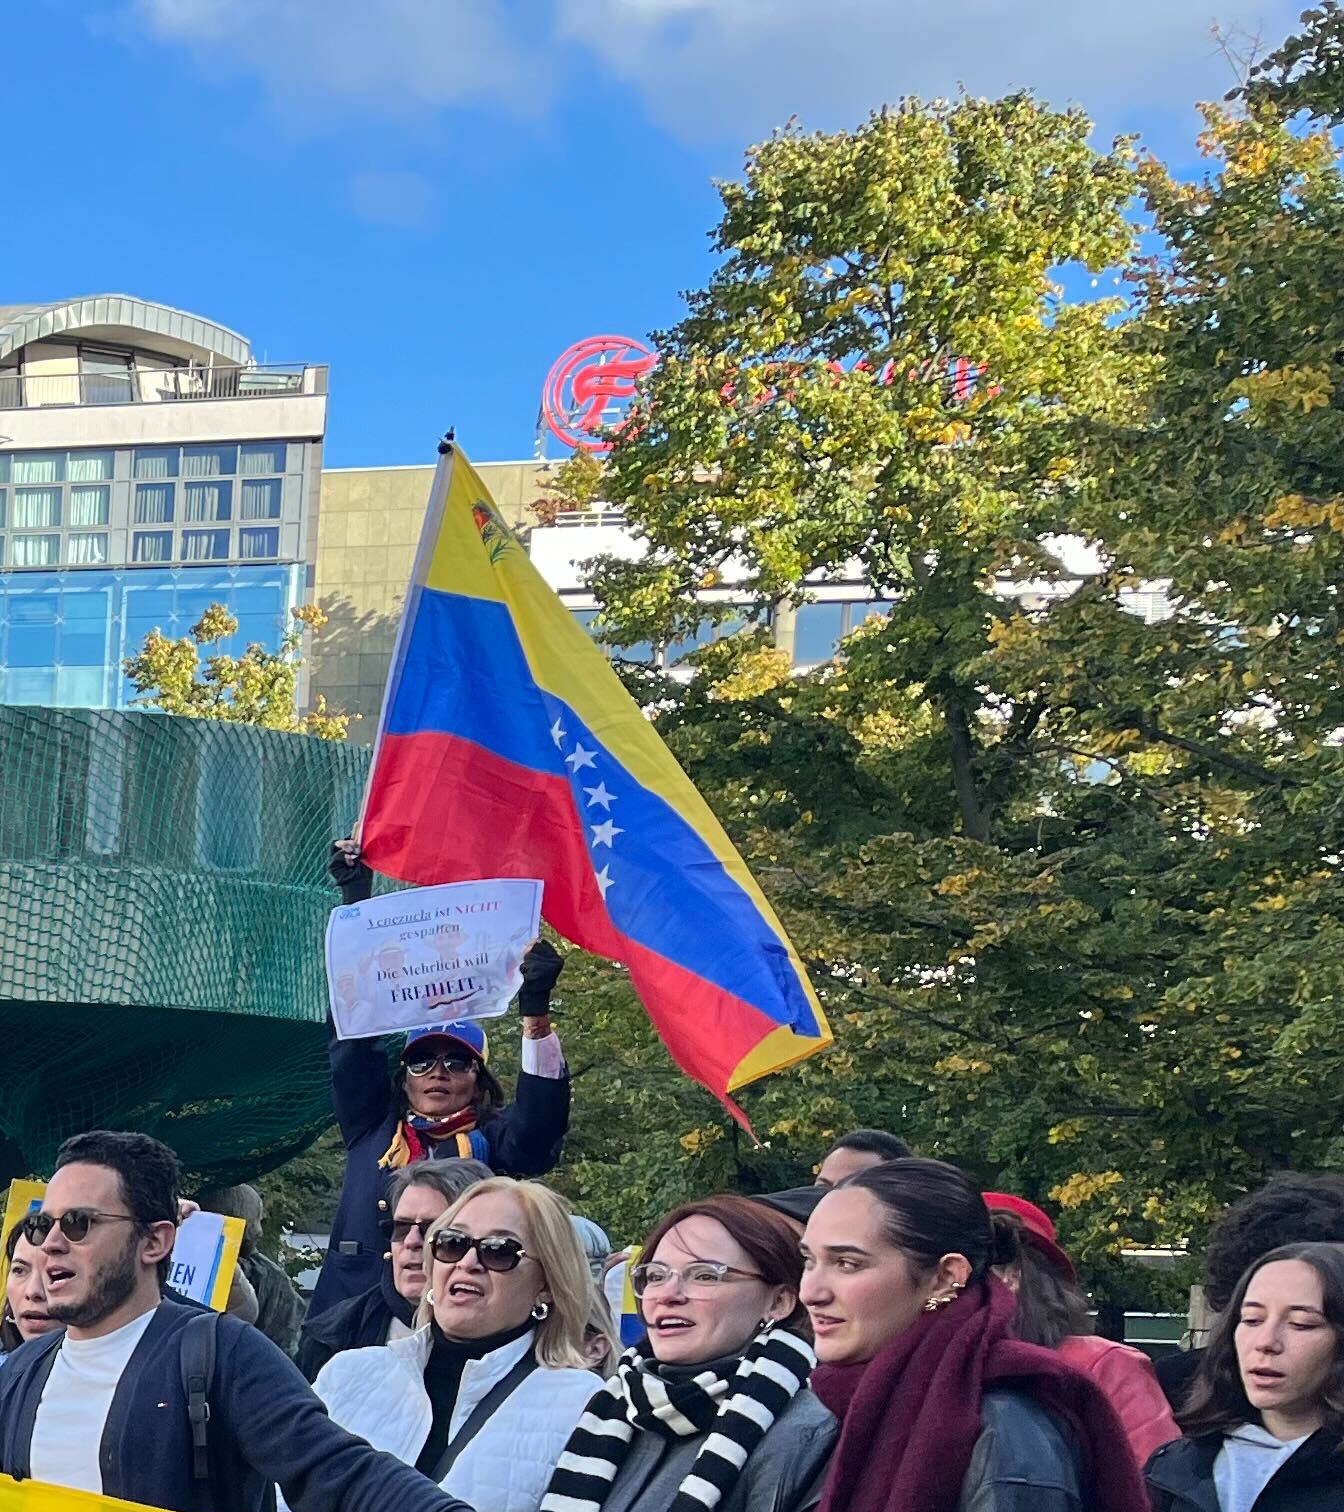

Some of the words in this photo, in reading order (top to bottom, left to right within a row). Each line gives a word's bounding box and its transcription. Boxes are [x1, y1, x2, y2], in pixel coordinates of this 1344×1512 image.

[368, 909, 432, 929] Venezuela
[434, 905, 450, 919] ist
[454, 900, 503, 916] NICHT
[376, 968, 399, 983] Die
[401, 957, 461, 978] Mehrheit
[464, 952, 490, 967] will
